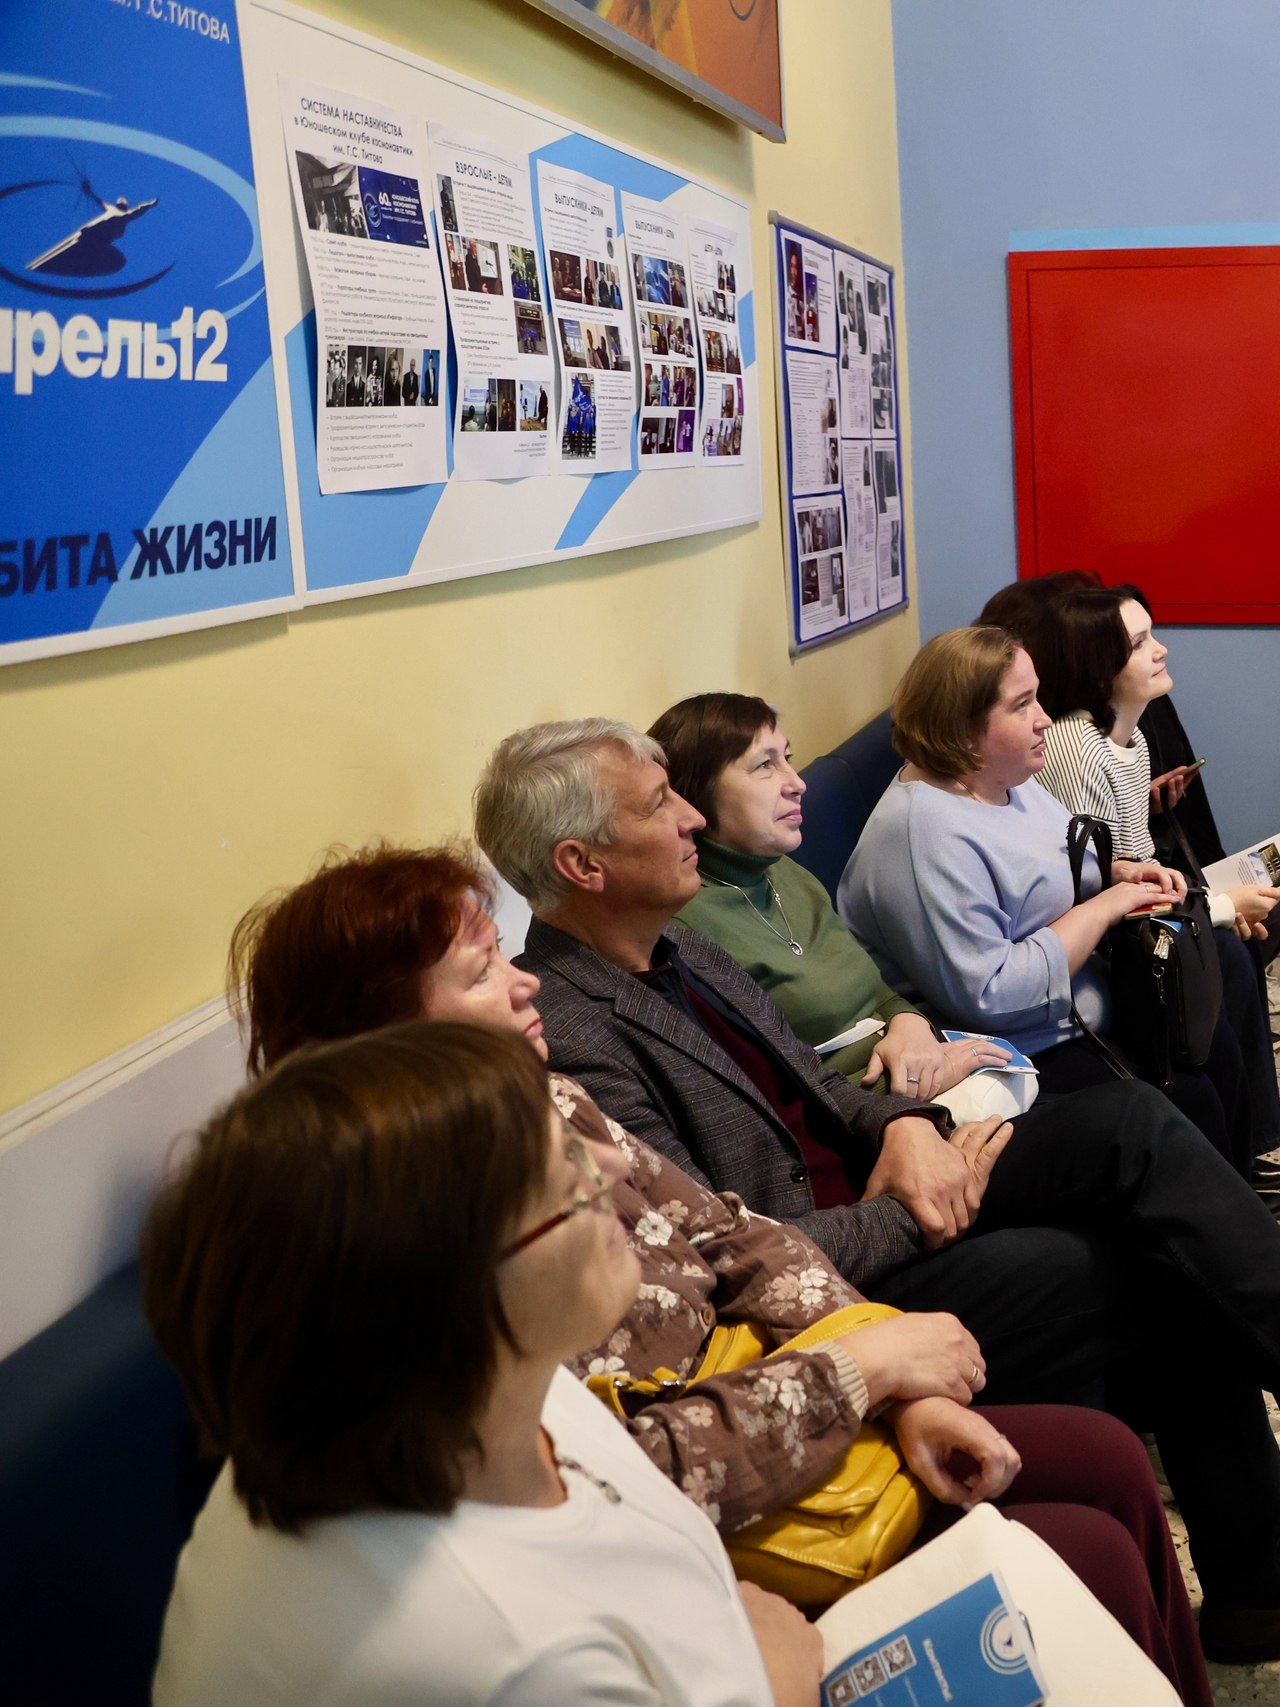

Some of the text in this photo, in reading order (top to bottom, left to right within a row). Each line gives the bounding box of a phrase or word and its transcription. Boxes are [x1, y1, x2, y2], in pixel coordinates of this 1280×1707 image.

[300, 97, 403, 138] СИСТЕМА НАСТАВНИЧЕСТВА
[300, 116, 347, 138] Юношеском
[349, 131, 371, 145] клубе
[455, 161, 493, 181] ВЗРОСЛЫЕ
[130, 516, 277, 580] ЖИЗНИ
